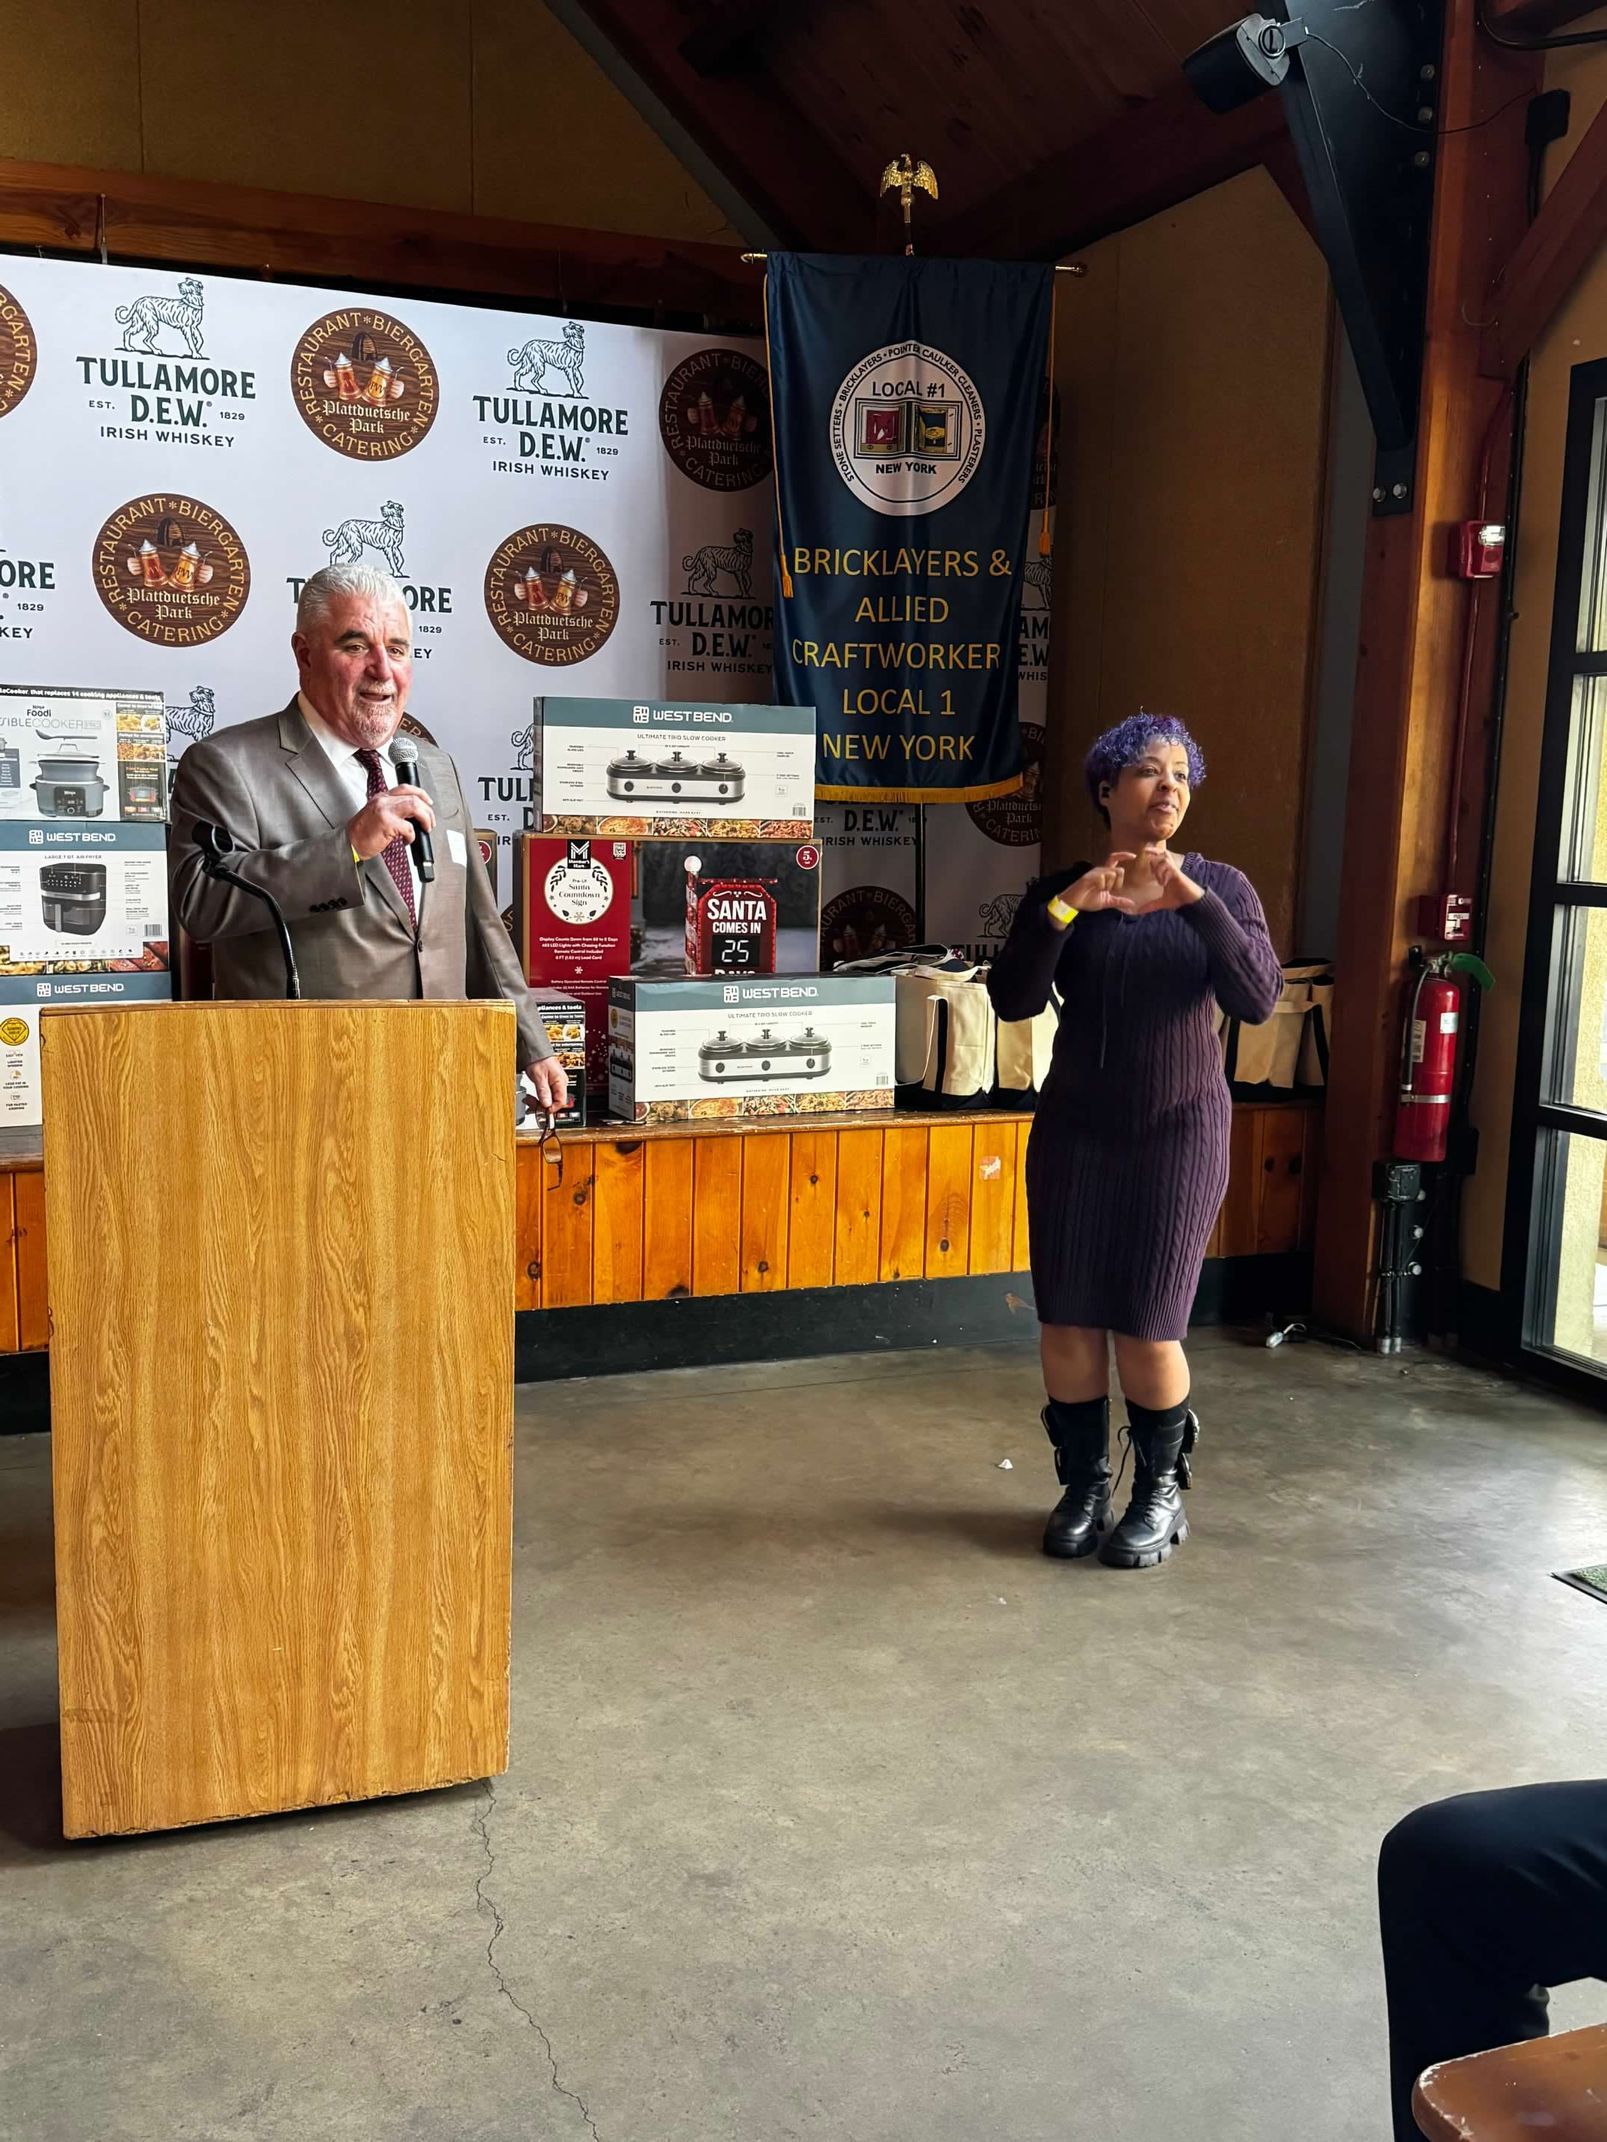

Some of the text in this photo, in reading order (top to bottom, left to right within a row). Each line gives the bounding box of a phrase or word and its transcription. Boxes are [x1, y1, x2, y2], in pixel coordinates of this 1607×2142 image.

[0, 292, 30, 391] GARTEN
[76, 356, 256, 399] TULLAMORE
[298, 312, 361, 415] RESTAURANT
[372, 315, 434, 428] BIERGARTEN
[840, 353, 883, 401] BRICKLAYERS
[872, 380, 945, 398] LOCAL #1
[922, 349, 959, 377] CAULKER
[958, 375, 982, 420] CLEANERS
[89, 394, 245, 428] EST. D.E.W. 1829
[322, 400, 410, 421] Plattduetsche
[472, 395, 628, 435] TULLAMORE
[665, 353, 720, 449] RESTAURANT
[100, 426, 234, 447] IRISH WHISKEY
[323, 423, 414, 457] CATERING
[349, 418, 384, 434] Park
[483, 431, 618, 462] EST. D.E.W. 1829
[708, 451, 739, 466] Park
[833, 409, 854, 482] STONE SETTERS
[958, 428, 982, 483] PLASTERERS
[493, 461, 609, 480] IRISH WHISKEY
[685, 457, 763, 487] CATERING
[876, 462, 937, 474] NEW YORK
[99, 498, 166, 603] RESTAURANT
[178, 501, 244, 611] BIERGARTEN
[794, 547, 1013, 577] BRICKLAYERS &
[491, 528, 549, 626] RESTAURANT
[559, 530, 615, 633] BIERGARTEN
[17, 603, 44, 611] 1829
[126, 587, 220, 607] Plattduetsche
[855, 595, 949, 623] ALLIED
[155, 604, 192, 620] Park
[512, 612, 593, 629] Plattduetsche
[127, 611, 224, 642] CATERING
[538, 627, 569, 642] Park
[513, 633, 596, 662] CATERING
[659, 632, 752, 658] EST. D.E.W.
[792, 639, 1001, 670] CRAFTWORKER
[668, 661, 773, 674] IRISH WHISKEY
[27, 709, 51, 717] Foodi
[843, 688, 956, 715] LOCAL 1
[823, 733, 976, 761] NEW YORK
[822, 837, 855, 846] IRISH
[707, 899, 767, 921] SANTA
[713, 922, 761, 934] COMES IN
[721, 940, 749, 963] 25
